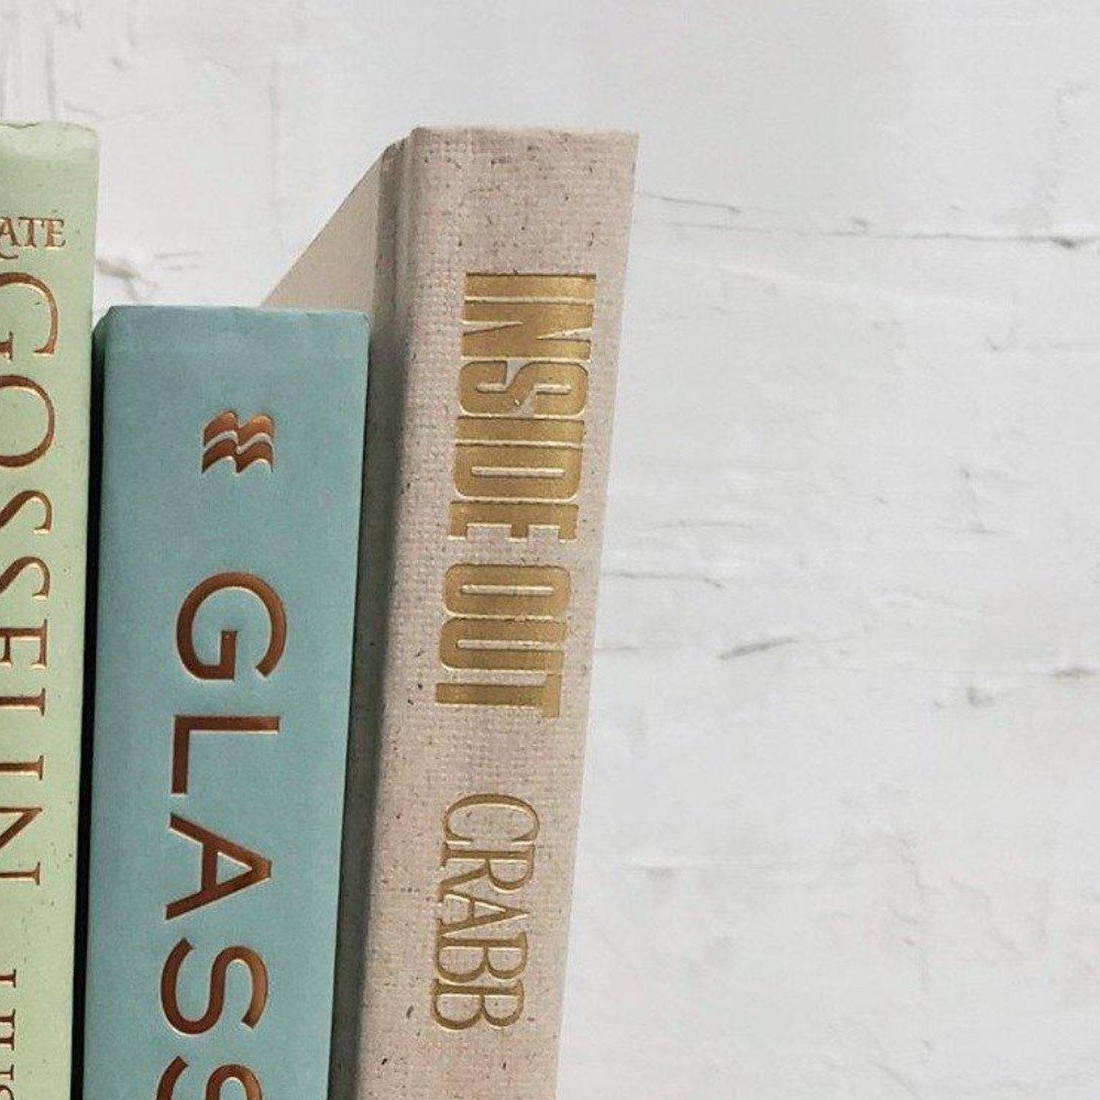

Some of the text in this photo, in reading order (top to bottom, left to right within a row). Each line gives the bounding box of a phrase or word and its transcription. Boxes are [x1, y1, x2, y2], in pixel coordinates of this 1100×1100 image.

[435, 272, 597, 718] INSIDE OUT
[431, 794, 540, 1029] CRABB
